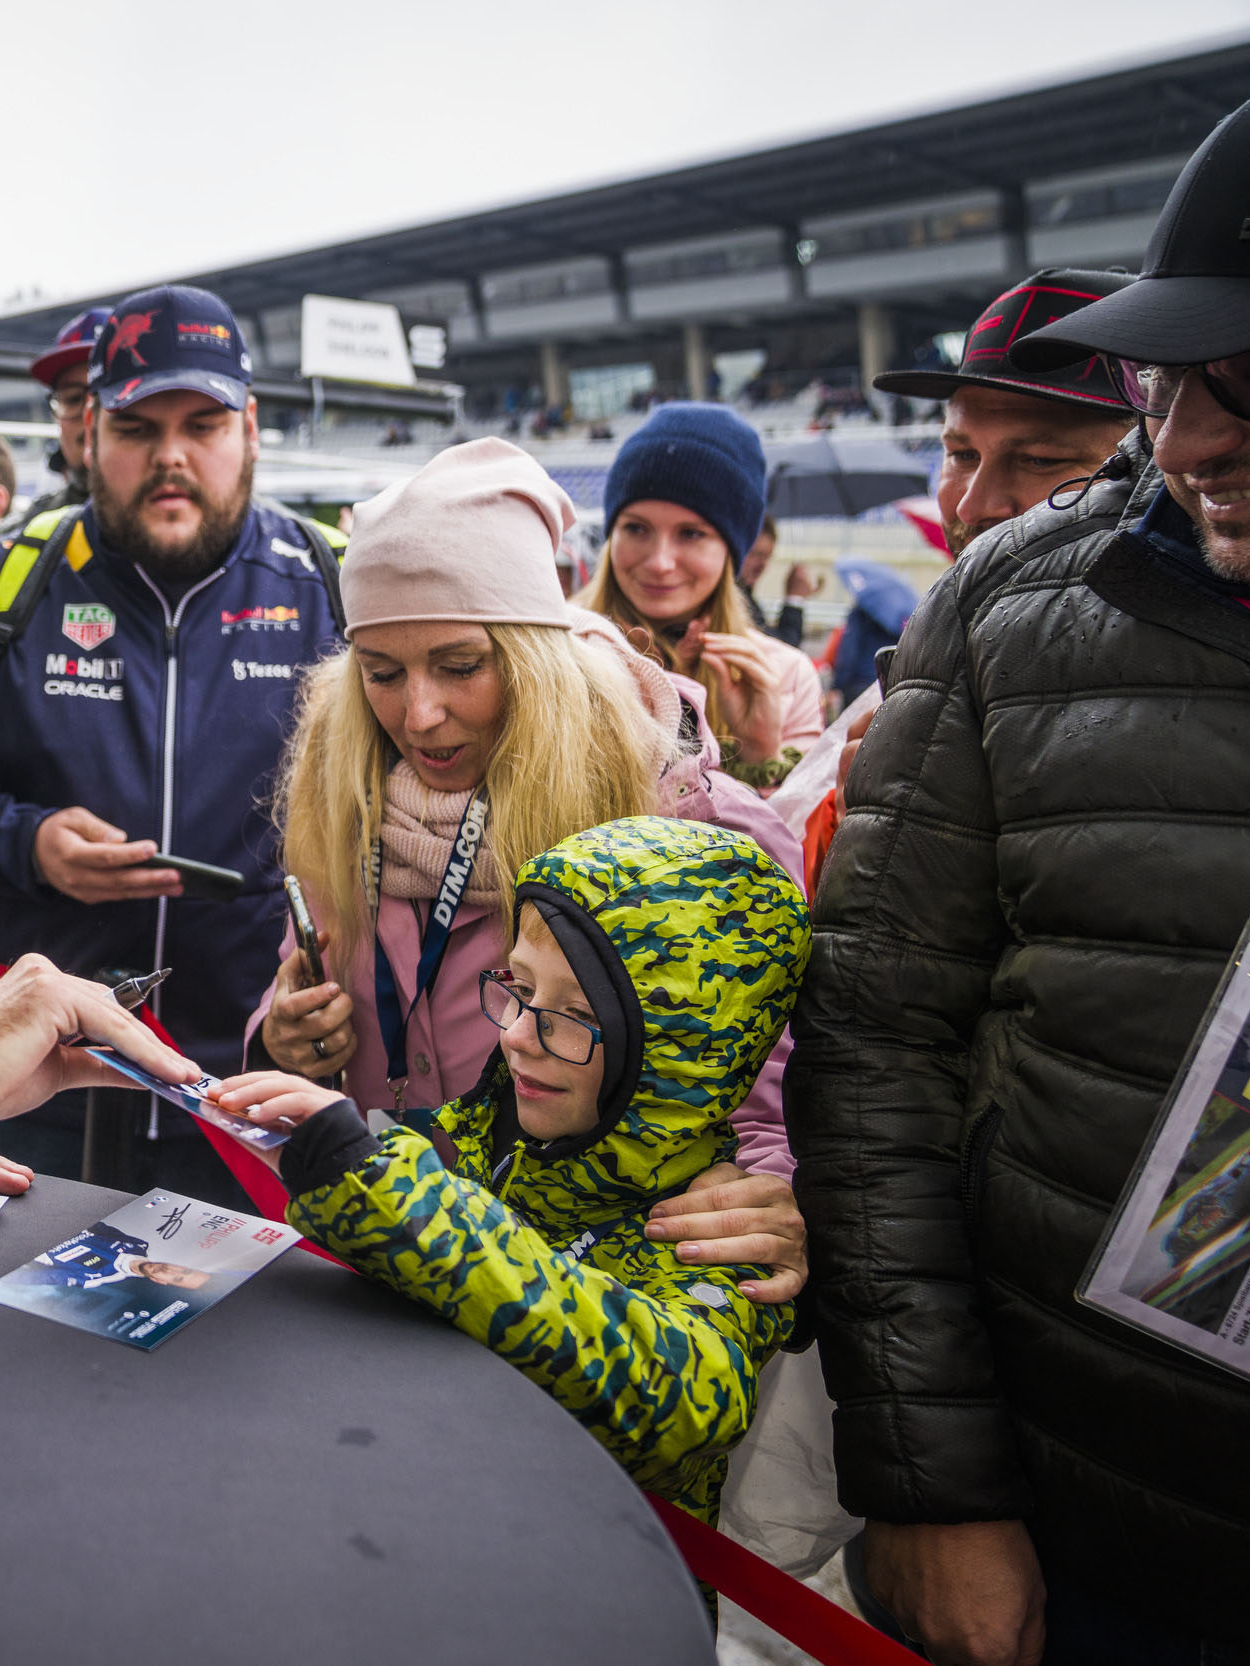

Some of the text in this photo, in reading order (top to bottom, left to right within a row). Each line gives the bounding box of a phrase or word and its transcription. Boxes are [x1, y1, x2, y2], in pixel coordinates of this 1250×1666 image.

[69, 607, 112, 622] TAG
[46, 653, 104, 679] Mobil
[247, 661, 291, 678] Tezos
[44, 680, 125, 701] ORACLE
[434, 799, 489, 929] DTM.COM
[251, 1227, 285, 1246] 25
